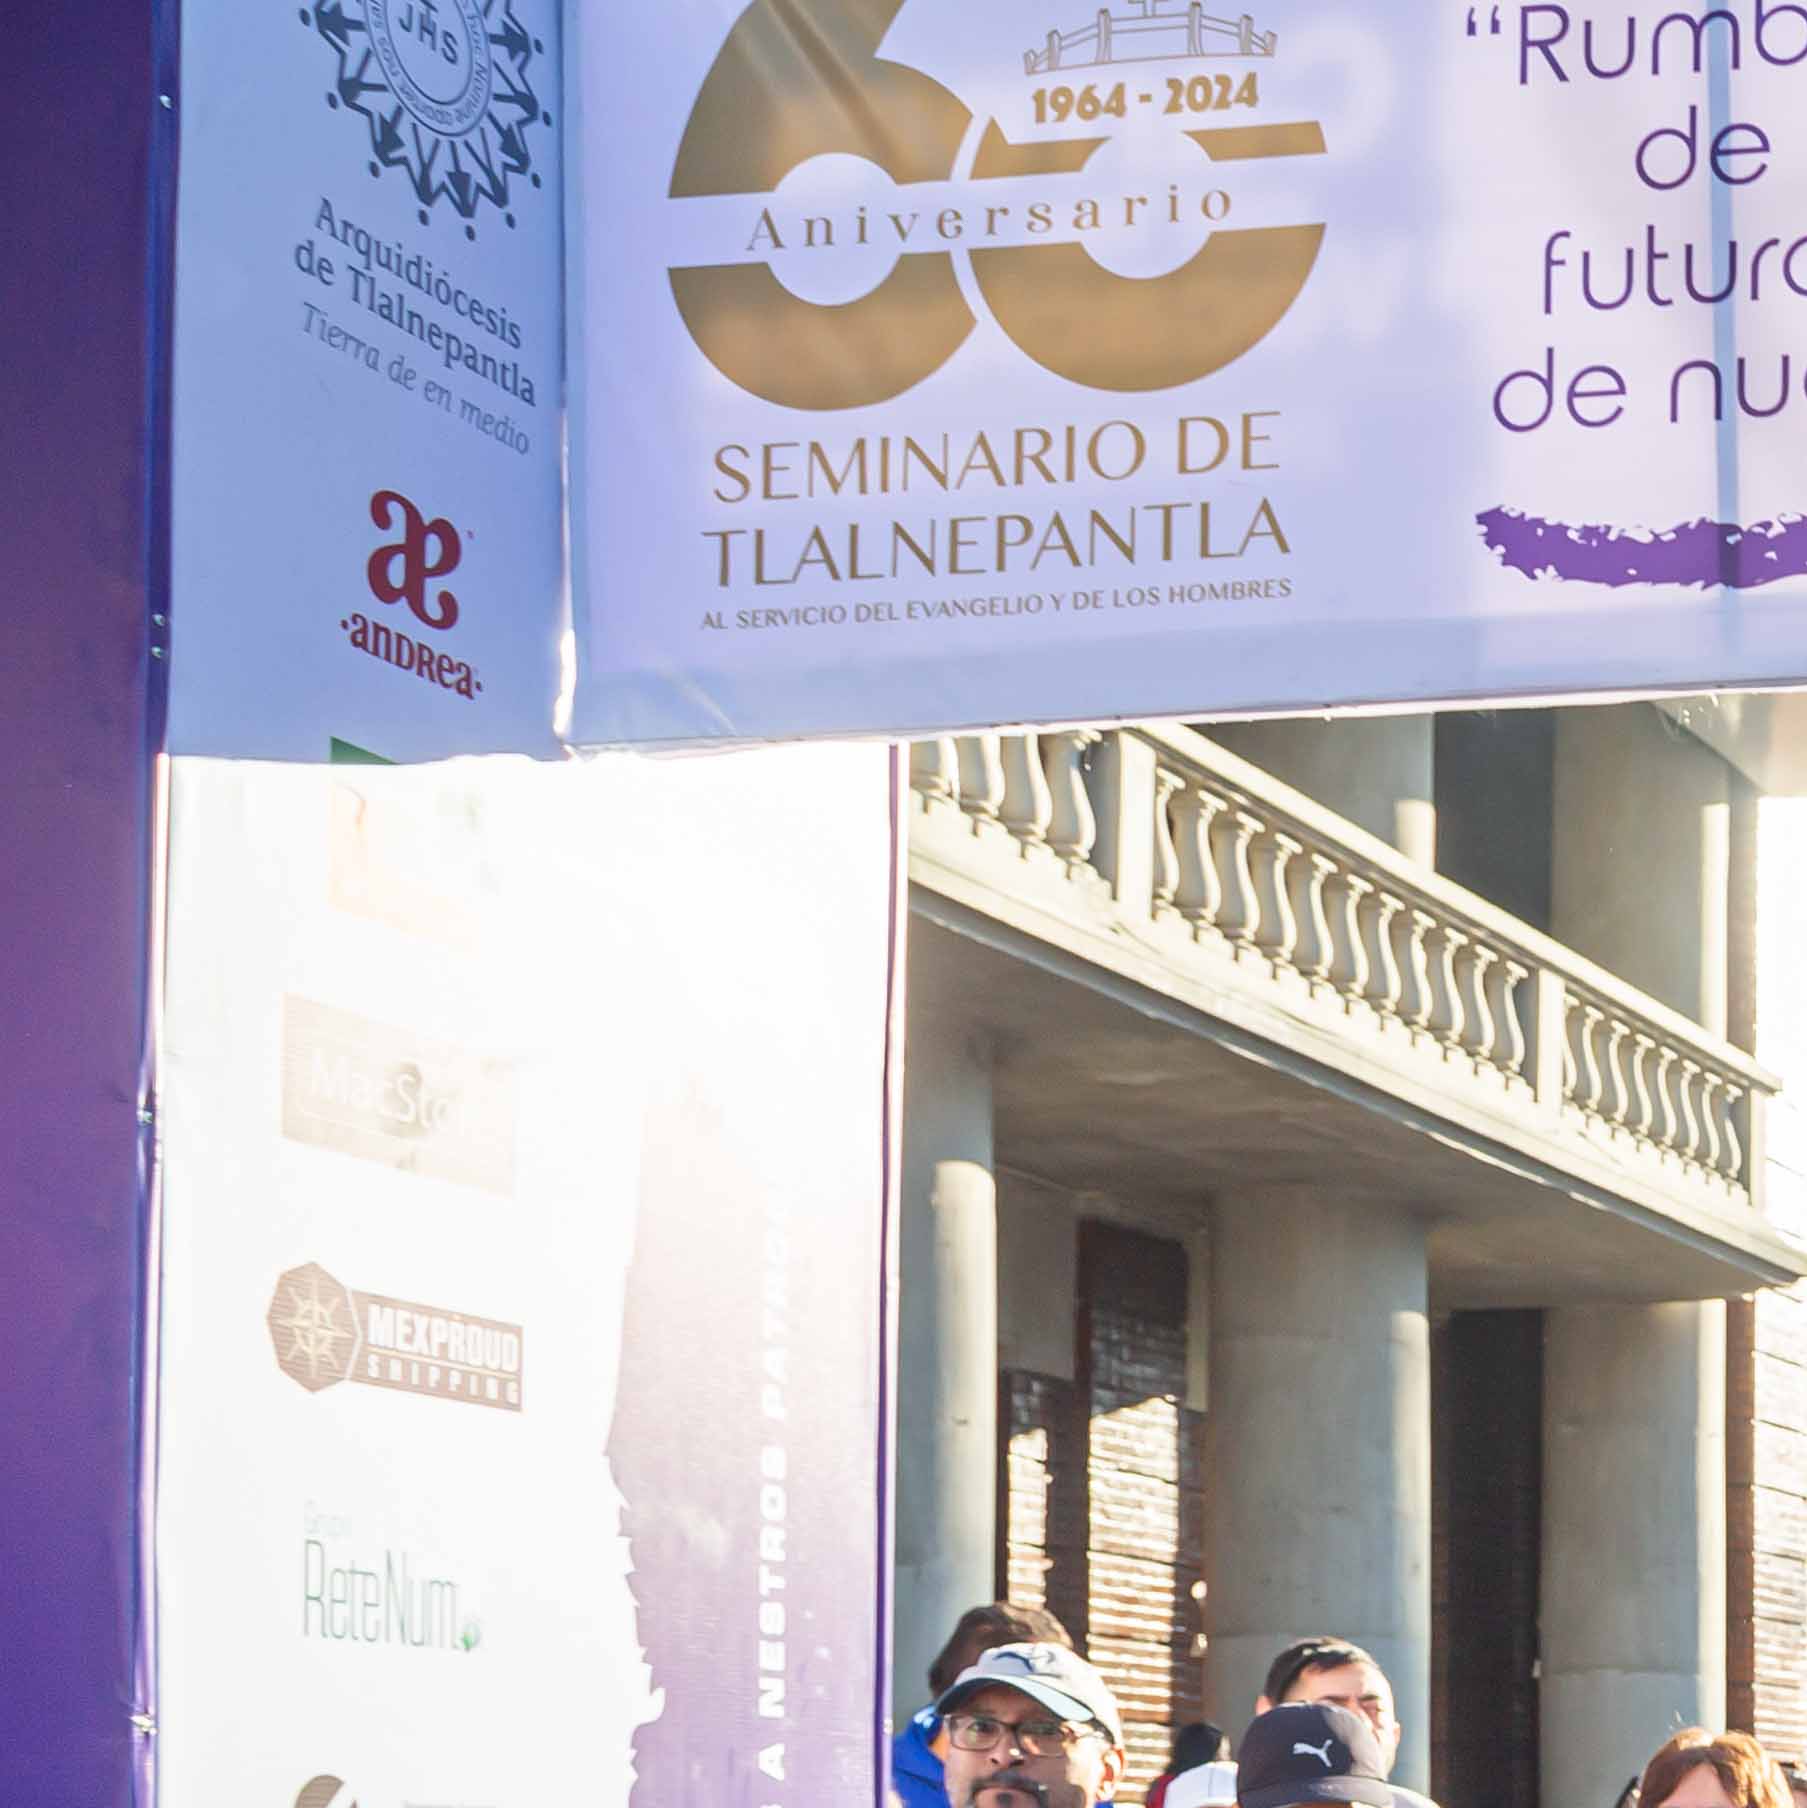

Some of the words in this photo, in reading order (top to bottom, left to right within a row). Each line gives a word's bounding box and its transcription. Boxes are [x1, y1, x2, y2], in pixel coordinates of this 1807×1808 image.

[1032, 82, 1126, 125] 1964
[1162, 72, 1260, 116] 2024
[1634, 104, 1772, 191] de
[746, 184, 1233, 253] Aniversario
[315, 196, 521, 349] Arquidiócesis
[295, 240, 335, 286] de
[347, 264, 536, 407] Tlalnepantla
[303, 301, 380, 372] Tierra
[388, 355, 417, 391] de
[424, 379, 452, 412] en
[460, 398, 529, 455] medio
[1492, 346, 1628, 434] de
[712, 419, 1148, 504] SEMINARIO
[1176, 411, 1282, 475] DE
[701, 496, 1292, 588] TLALNEPANTLA
[701, 610, 729, 631] AL
[736, 605, 846, 629] SERVICIO
[854, 602, 900, 624] DEL
[906, 592, 1042, 622] EVANGELIO
[1049, 591, 1065, 612] Y
[1072, 590, 1106, 610] DE
[1112, 586, 1160, 608] LOS
[1168, 578, 1293, 605] HOMBRES
[368, 1303, 519, 1373] MEXPROUD
[759, 1447, 787, 1719] NESTROS
[759, 1743, 786, 1783] A
